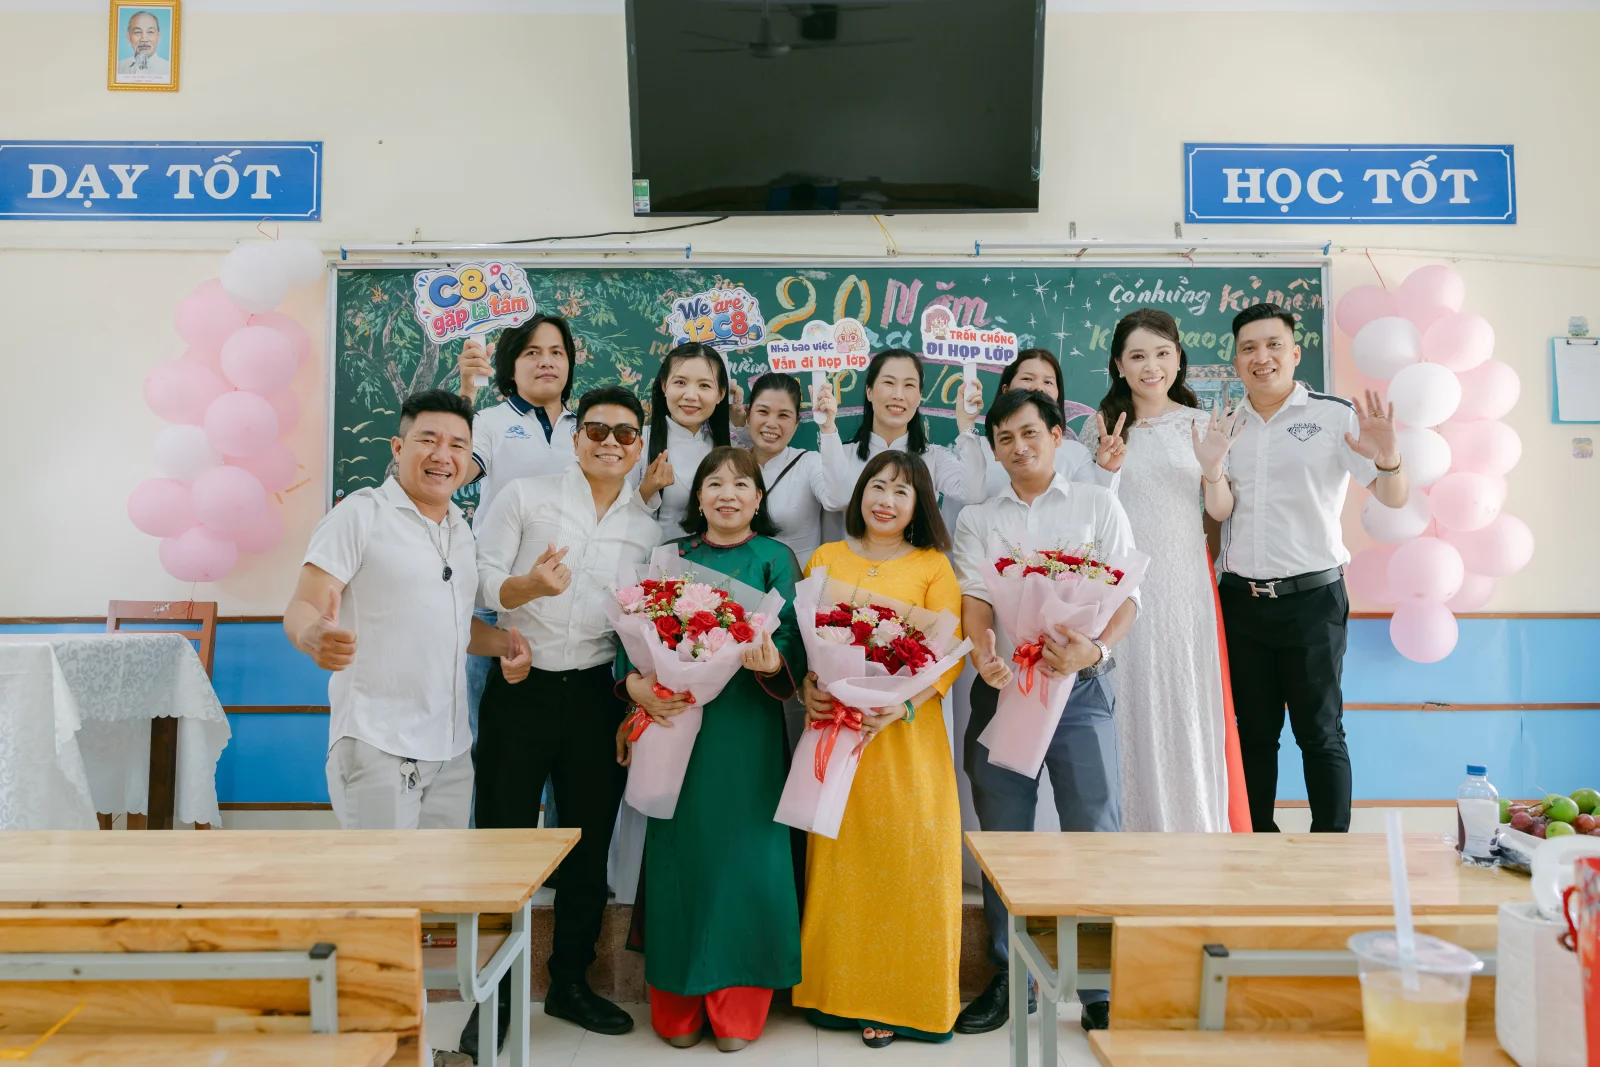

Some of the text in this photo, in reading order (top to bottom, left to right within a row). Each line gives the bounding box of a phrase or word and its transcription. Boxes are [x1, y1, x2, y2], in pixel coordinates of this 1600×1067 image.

[27, 150, 281, 208] DẠY TỐT
[1222, 154, 1479, 213] HỌC TỐT
[428, 268, 488, 308] C8
[433, 294, 529, 337] gặp là tám
[678, 297, 745, 321] We are
[684, 311, 750, 343] 12C8
[949, 328, 977, 342] TRỐN
[980, 331, 1014, 345] CHỒNG
[770, 340, 835, 353] Nhà bao việc
[926, 342, 1015, 361] ĐI HỌP LỚP
[772, 356, 796, 370] Vẫn
[817, 355, 841, 369] họp
[846, 353, 867, 368] lớp
